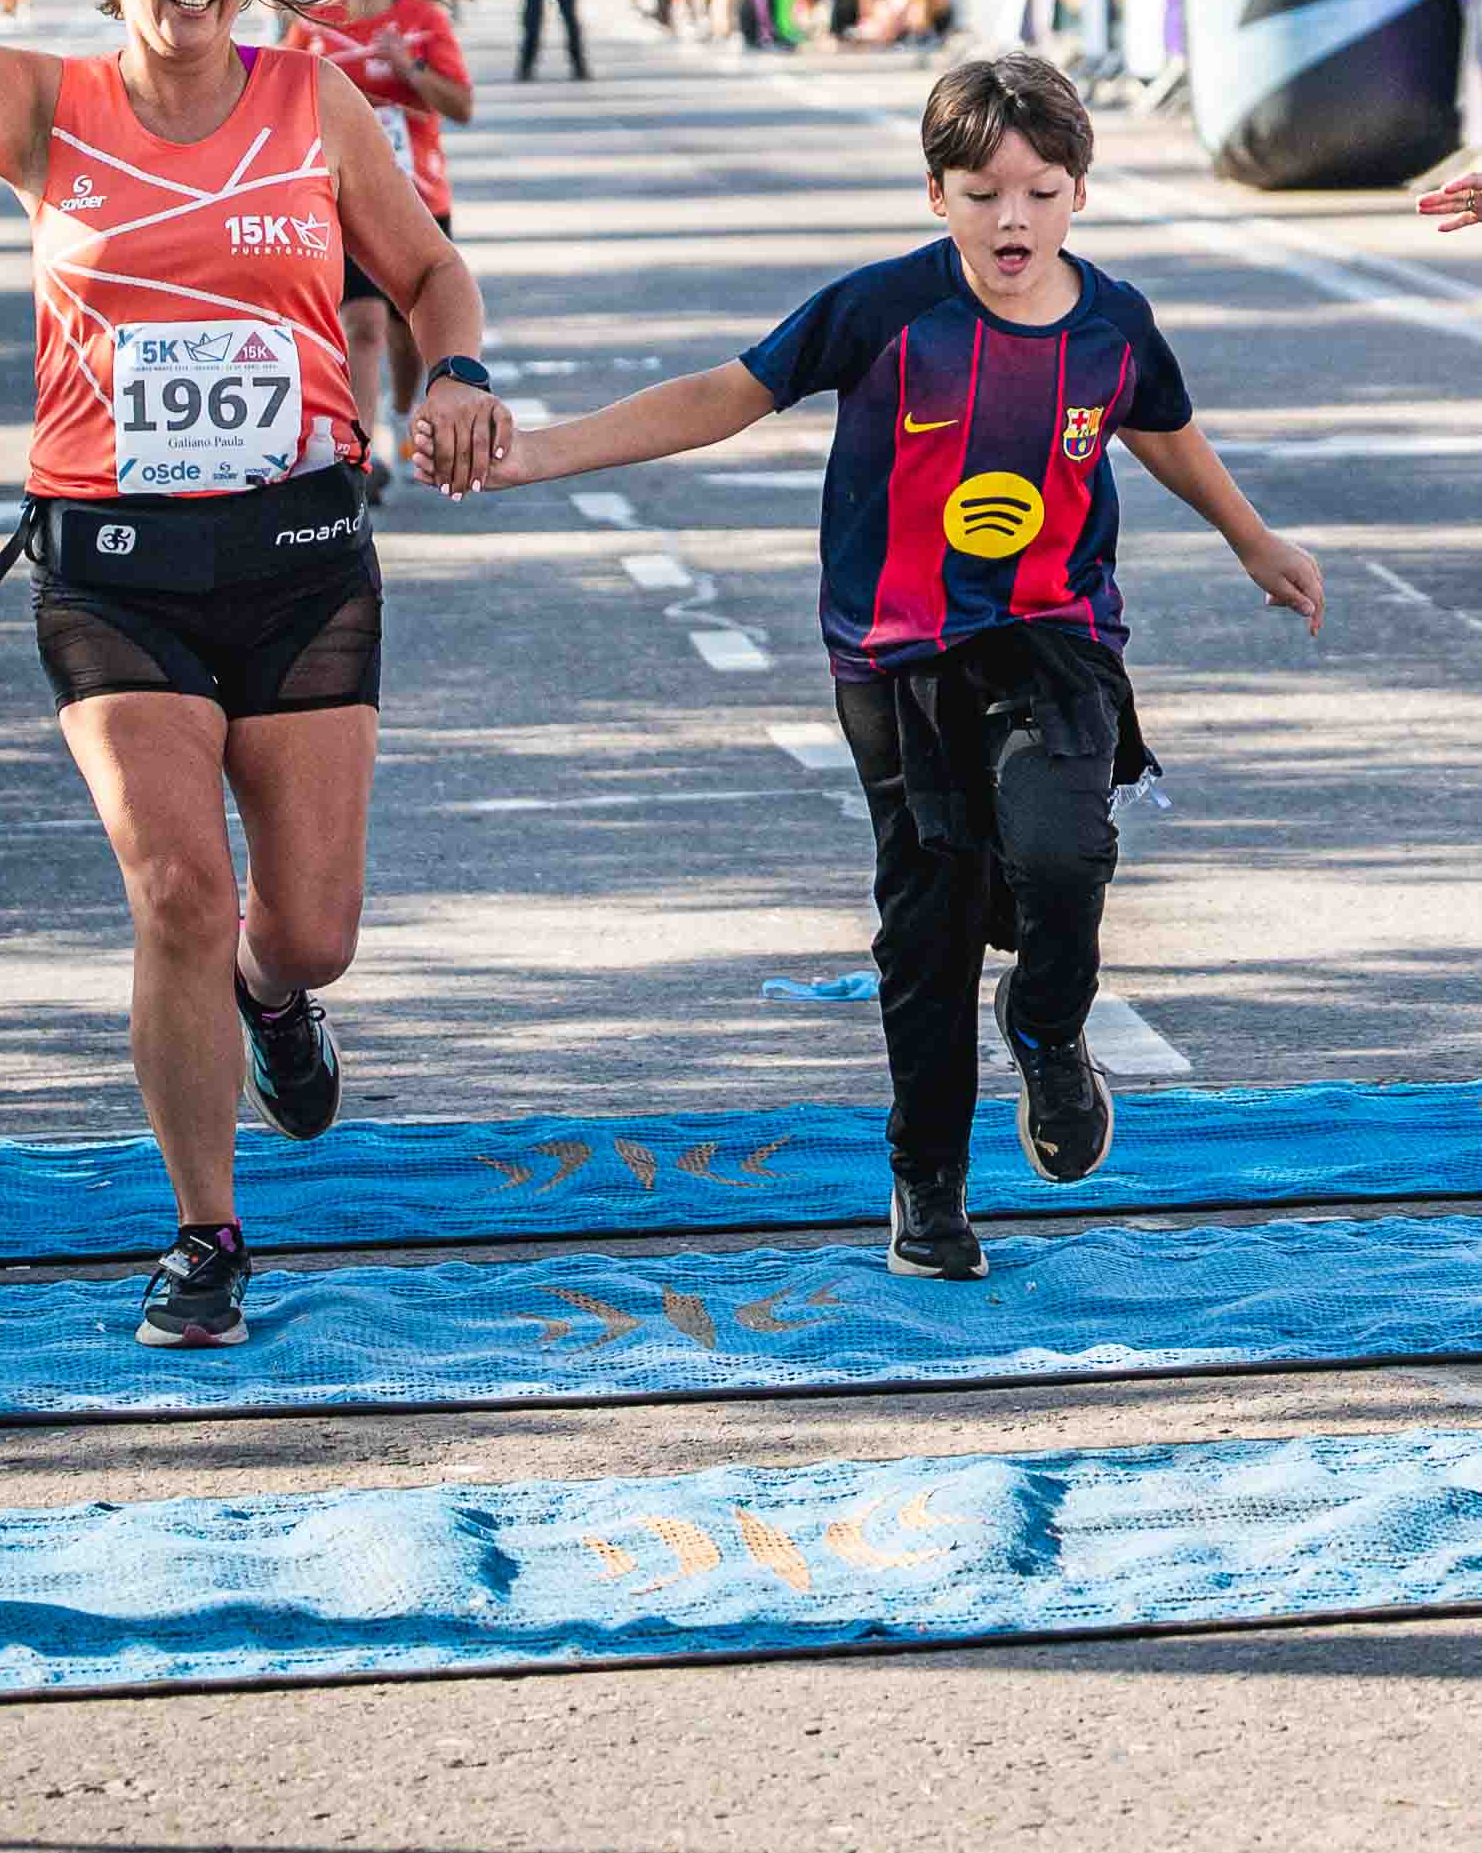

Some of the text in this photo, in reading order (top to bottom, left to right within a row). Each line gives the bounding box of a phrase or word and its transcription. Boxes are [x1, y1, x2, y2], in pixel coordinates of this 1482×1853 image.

[224, 215, 290, 246] 15K
[242, 346, 268, 359] 15K
[122, 376, 291, 432] 1967
[168, 435, 245, 449] Galiano Paula
[142, 459, 201, 485] osde
